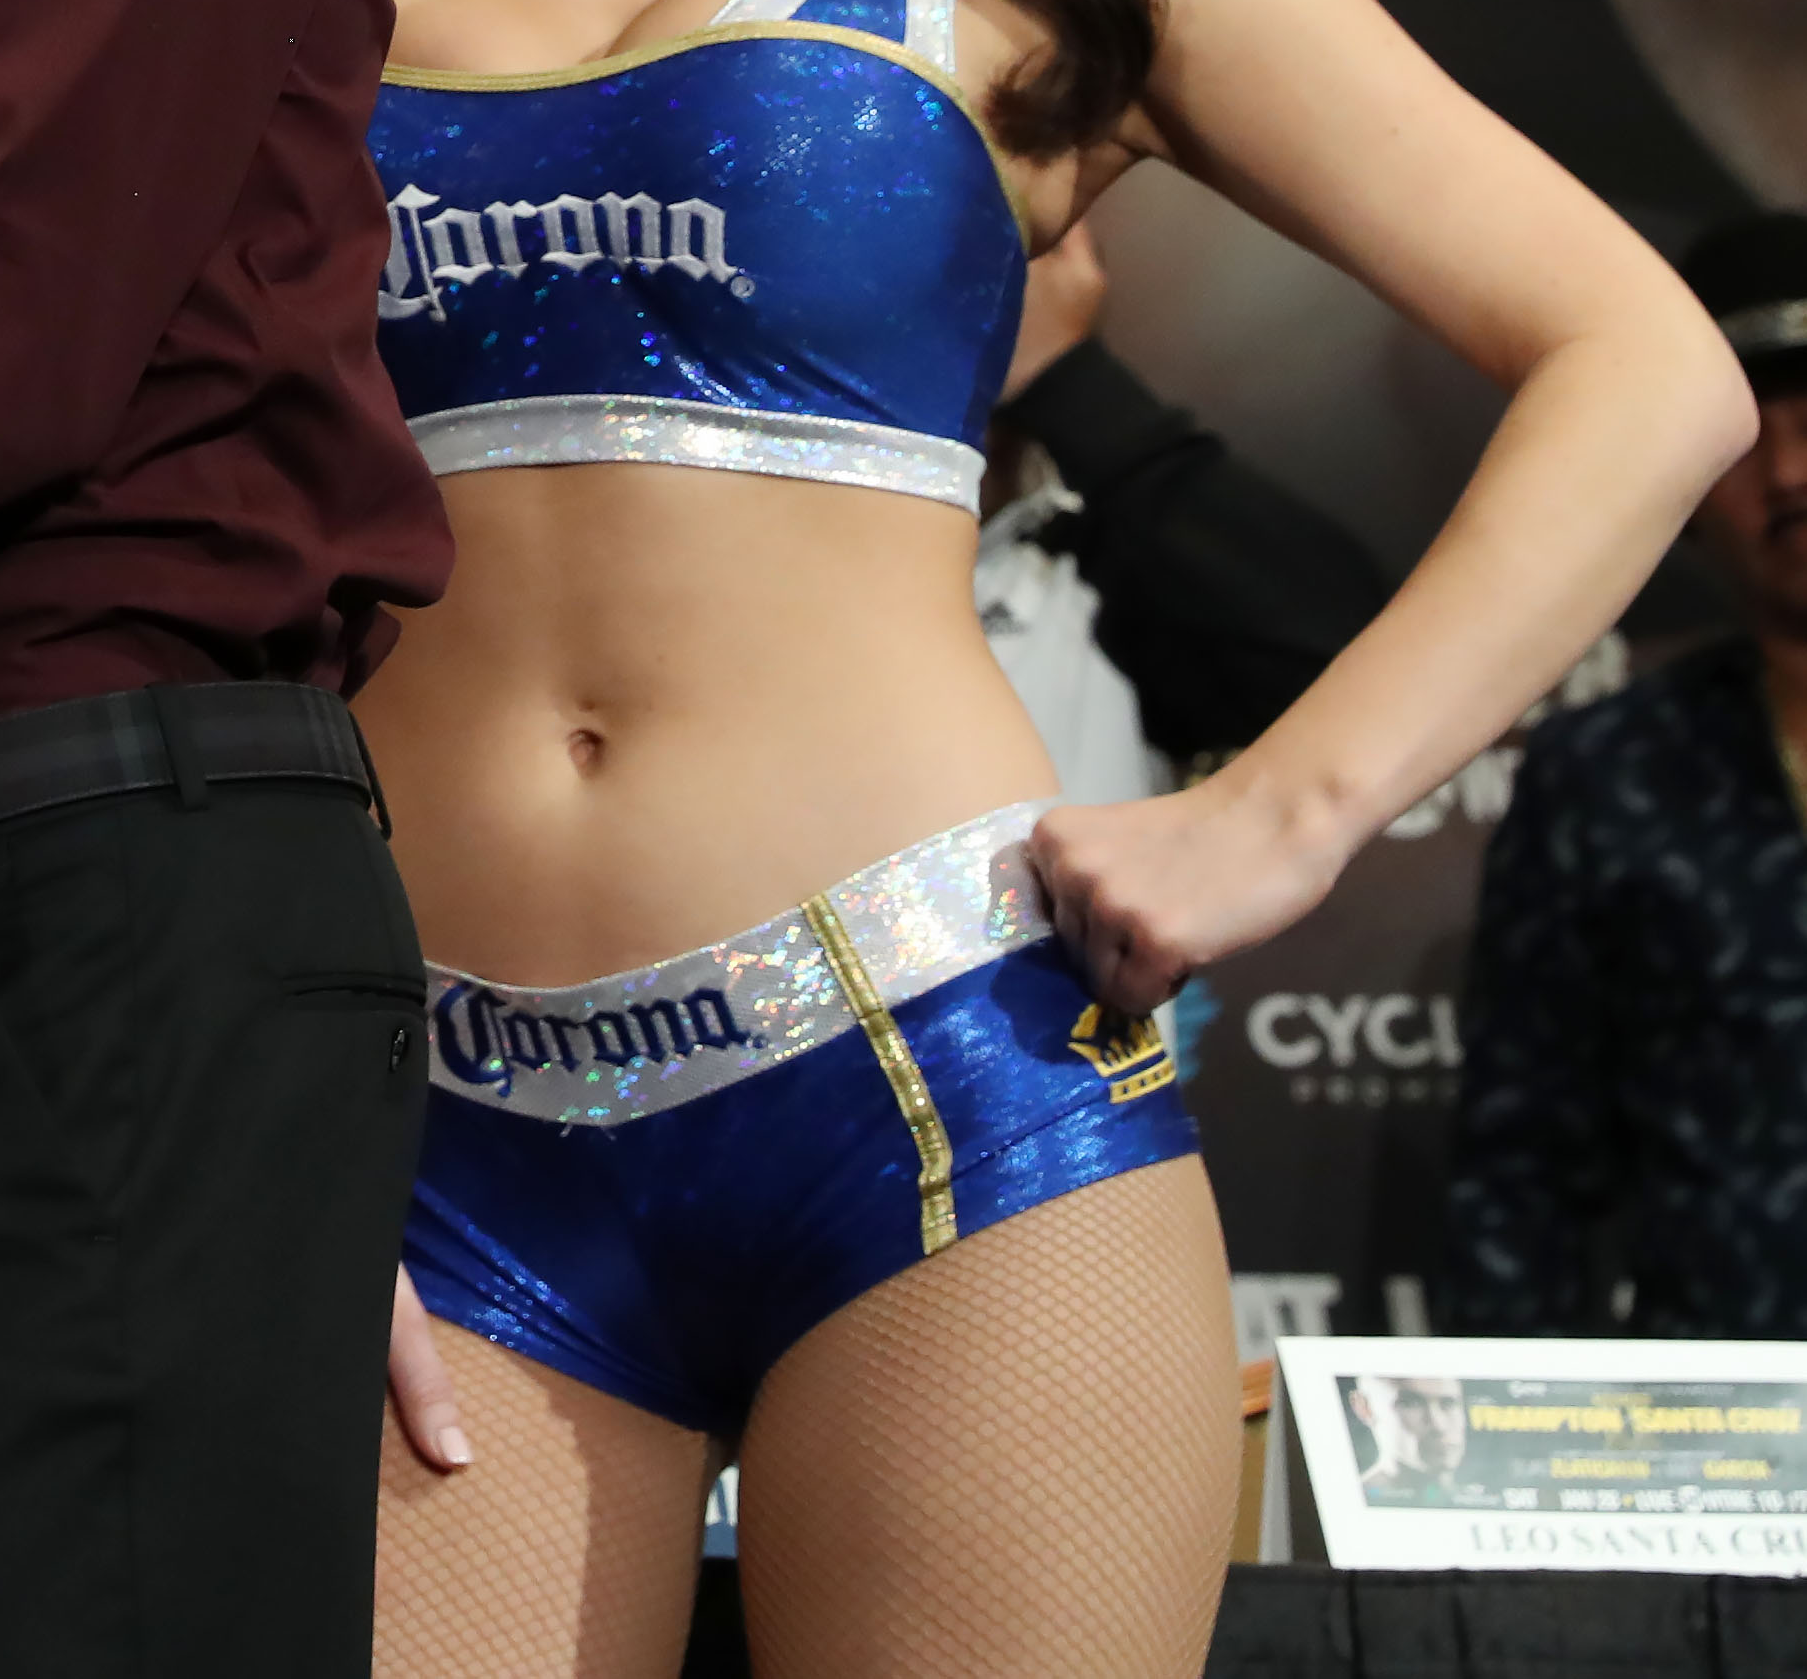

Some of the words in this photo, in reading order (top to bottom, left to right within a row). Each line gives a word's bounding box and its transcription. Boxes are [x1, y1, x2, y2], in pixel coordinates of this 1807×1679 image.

[432, 981, 753, 1097] Corona
[1470, 1522, 1559, 1555] LEO
[1568, 1524, 1718, 1559] SANTA
